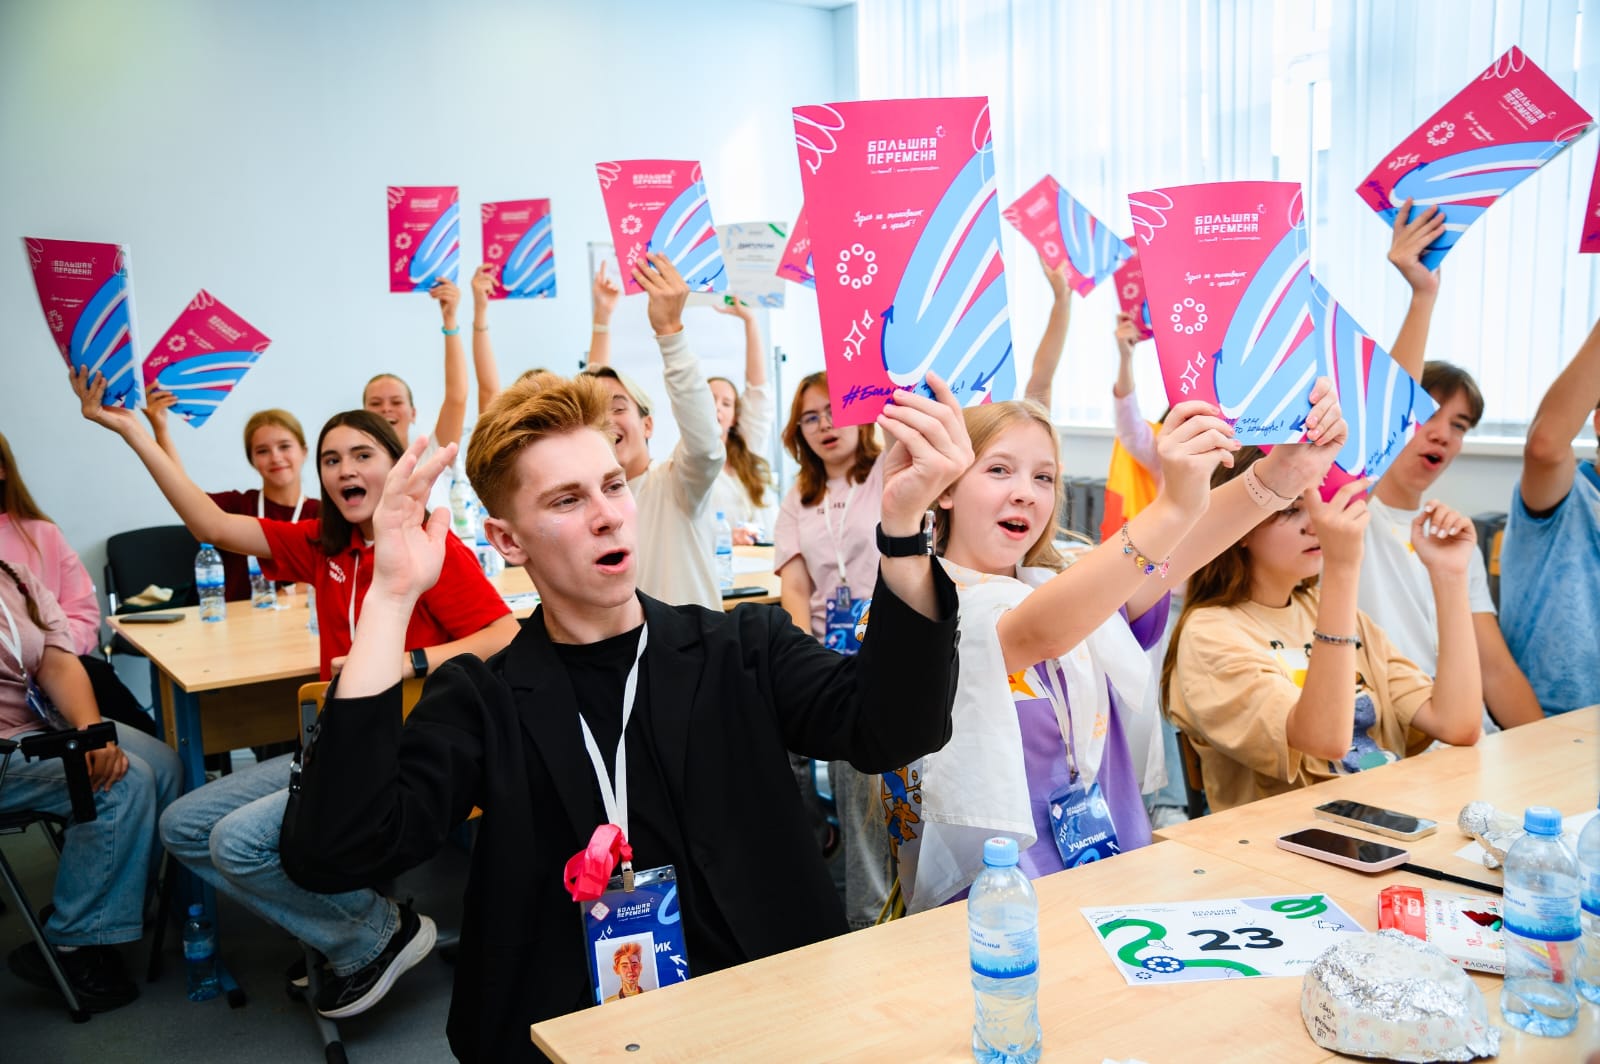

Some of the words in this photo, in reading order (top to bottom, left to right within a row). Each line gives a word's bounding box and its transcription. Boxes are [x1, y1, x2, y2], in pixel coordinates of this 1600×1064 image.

[1503, 92, 1539, 126] ПЕРЕМЕНА
[1510, 87, 1547, 121] БОЛЬШАЯ
[868, 137, 937, 152] БОЛЬШАЯ
[867, 149, 937, 165] ПЕРЕМЕНА
[1194, 212, 1259, 225] БОЛЬШАЯ
[1194, 223, 1259, 235] ПЕРЕМЕНА
[1067, 830, 1108, 853] УЧАСТНИК
[1187, 927, 1284, 952] 23
